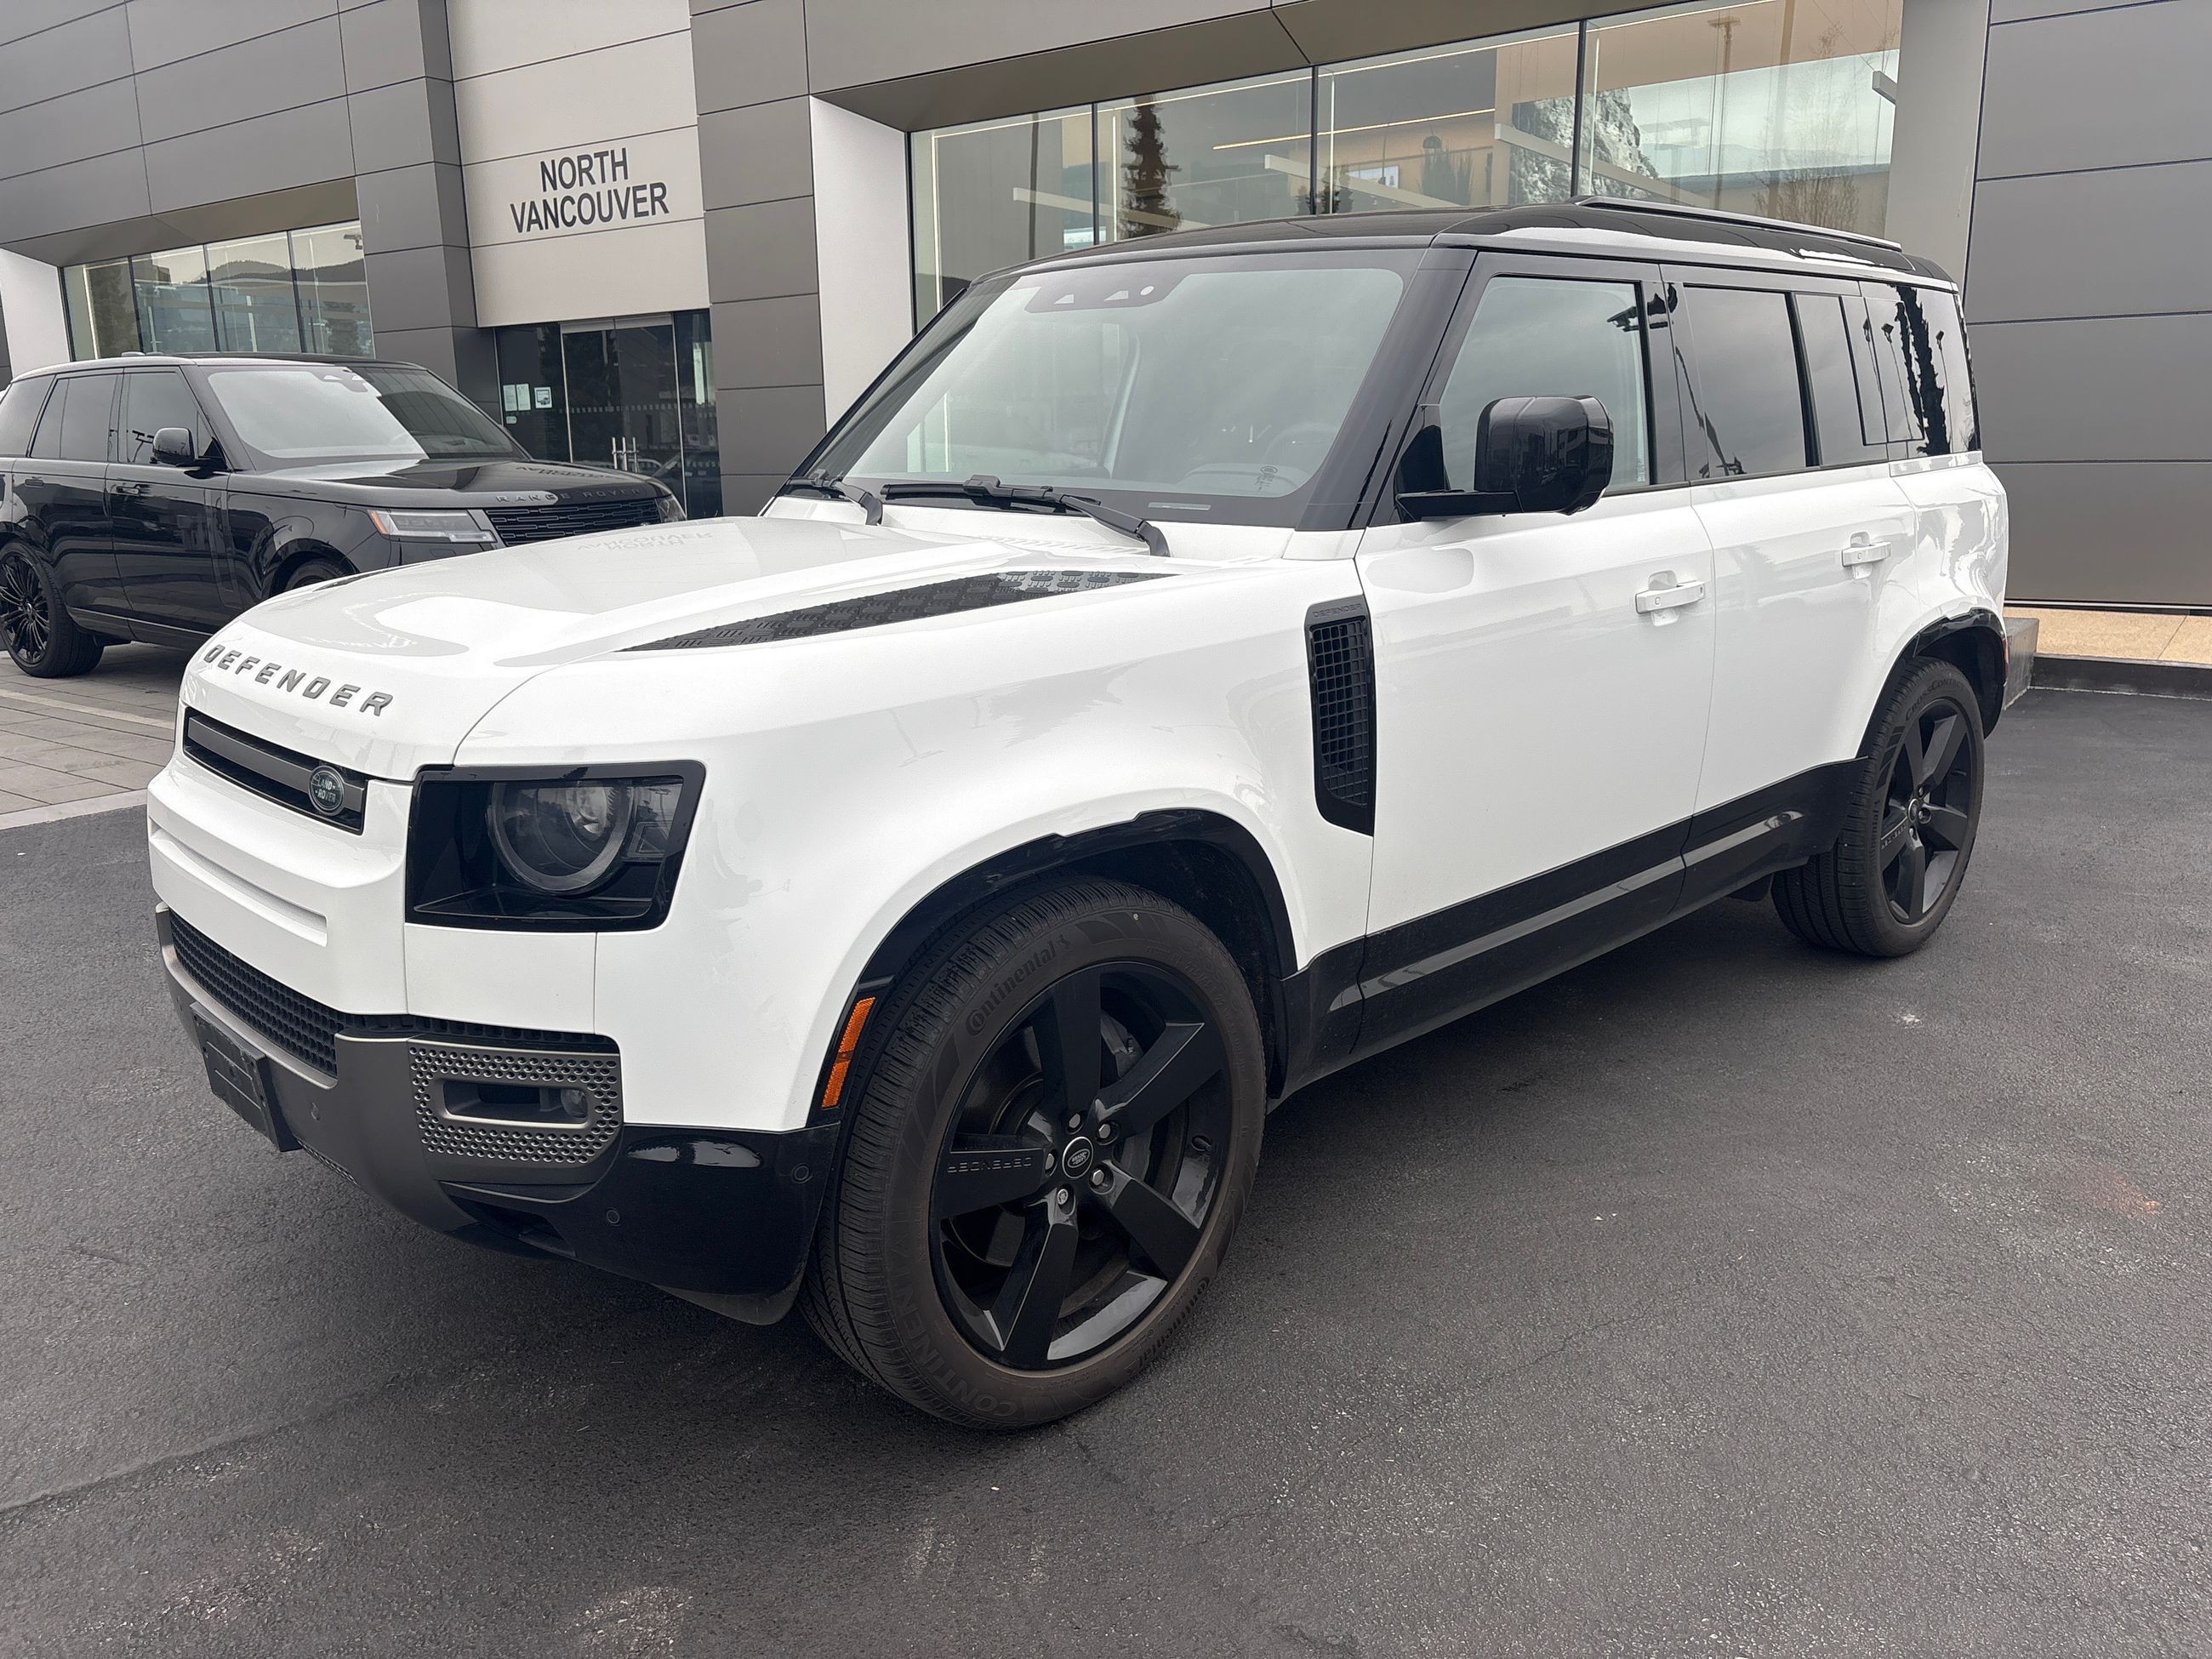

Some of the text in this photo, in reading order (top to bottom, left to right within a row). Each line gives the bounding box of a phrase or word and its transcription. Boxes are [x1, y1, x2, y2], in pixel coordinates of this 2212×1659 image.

[539, 147, 629, 192] NORTH
[510, 181, 670, 234] VANCOUVER
[496, 487, 641, 503] RANGE ROVER
[203, 644, 394, 716] DEFENDER
[965, 939, 1057, 1036] Continental
